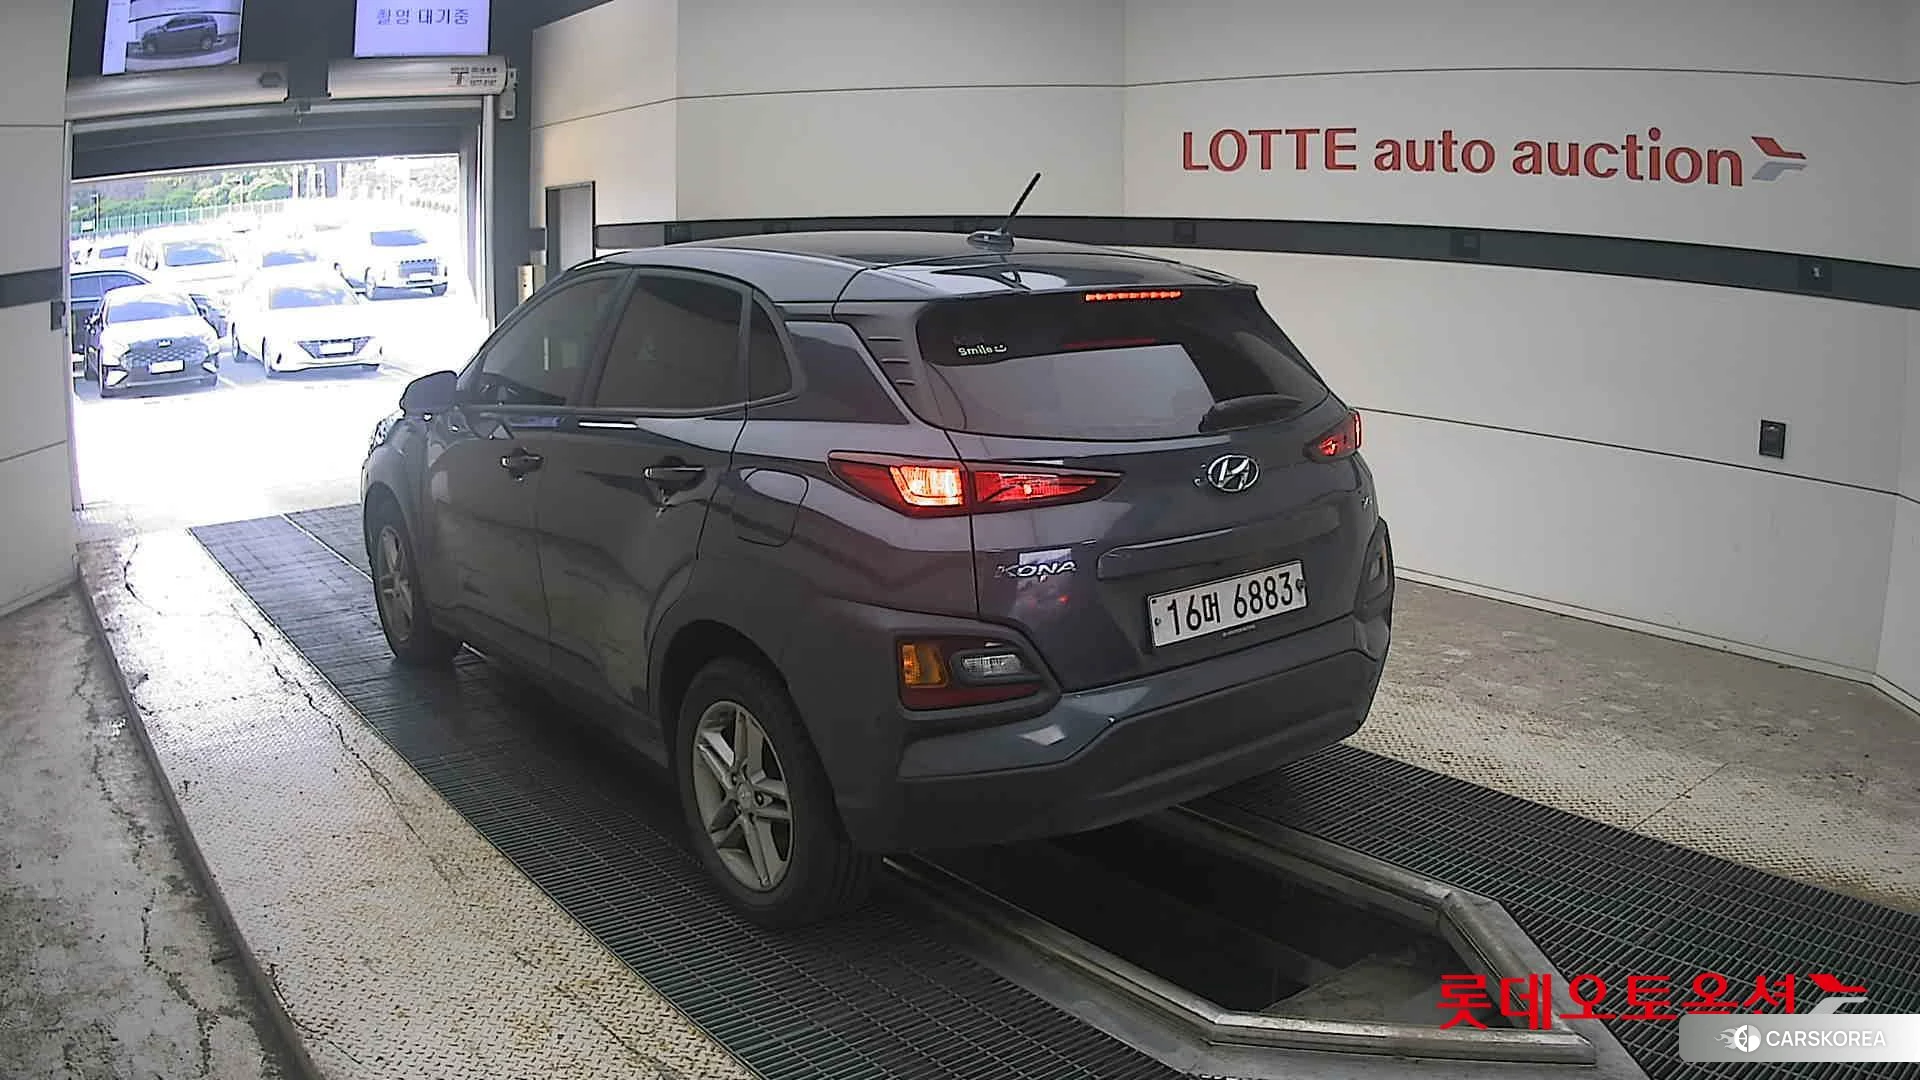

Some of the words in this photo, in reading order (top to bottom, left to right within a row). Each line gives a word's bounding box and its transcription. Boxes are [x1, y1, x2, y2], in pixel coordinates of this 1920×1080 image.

[419, 8, 469, 24] 대기중
[1183, 128, 1357, 171] LOTTE
[1374, 130, 1496, 173] auto
[1512, 127, 1743, 186] auction
[995, 561, 1077, 577] KONA
[1167, 591, 1221, 636] 16머
[1233, 571, 1293, 619] 6883
